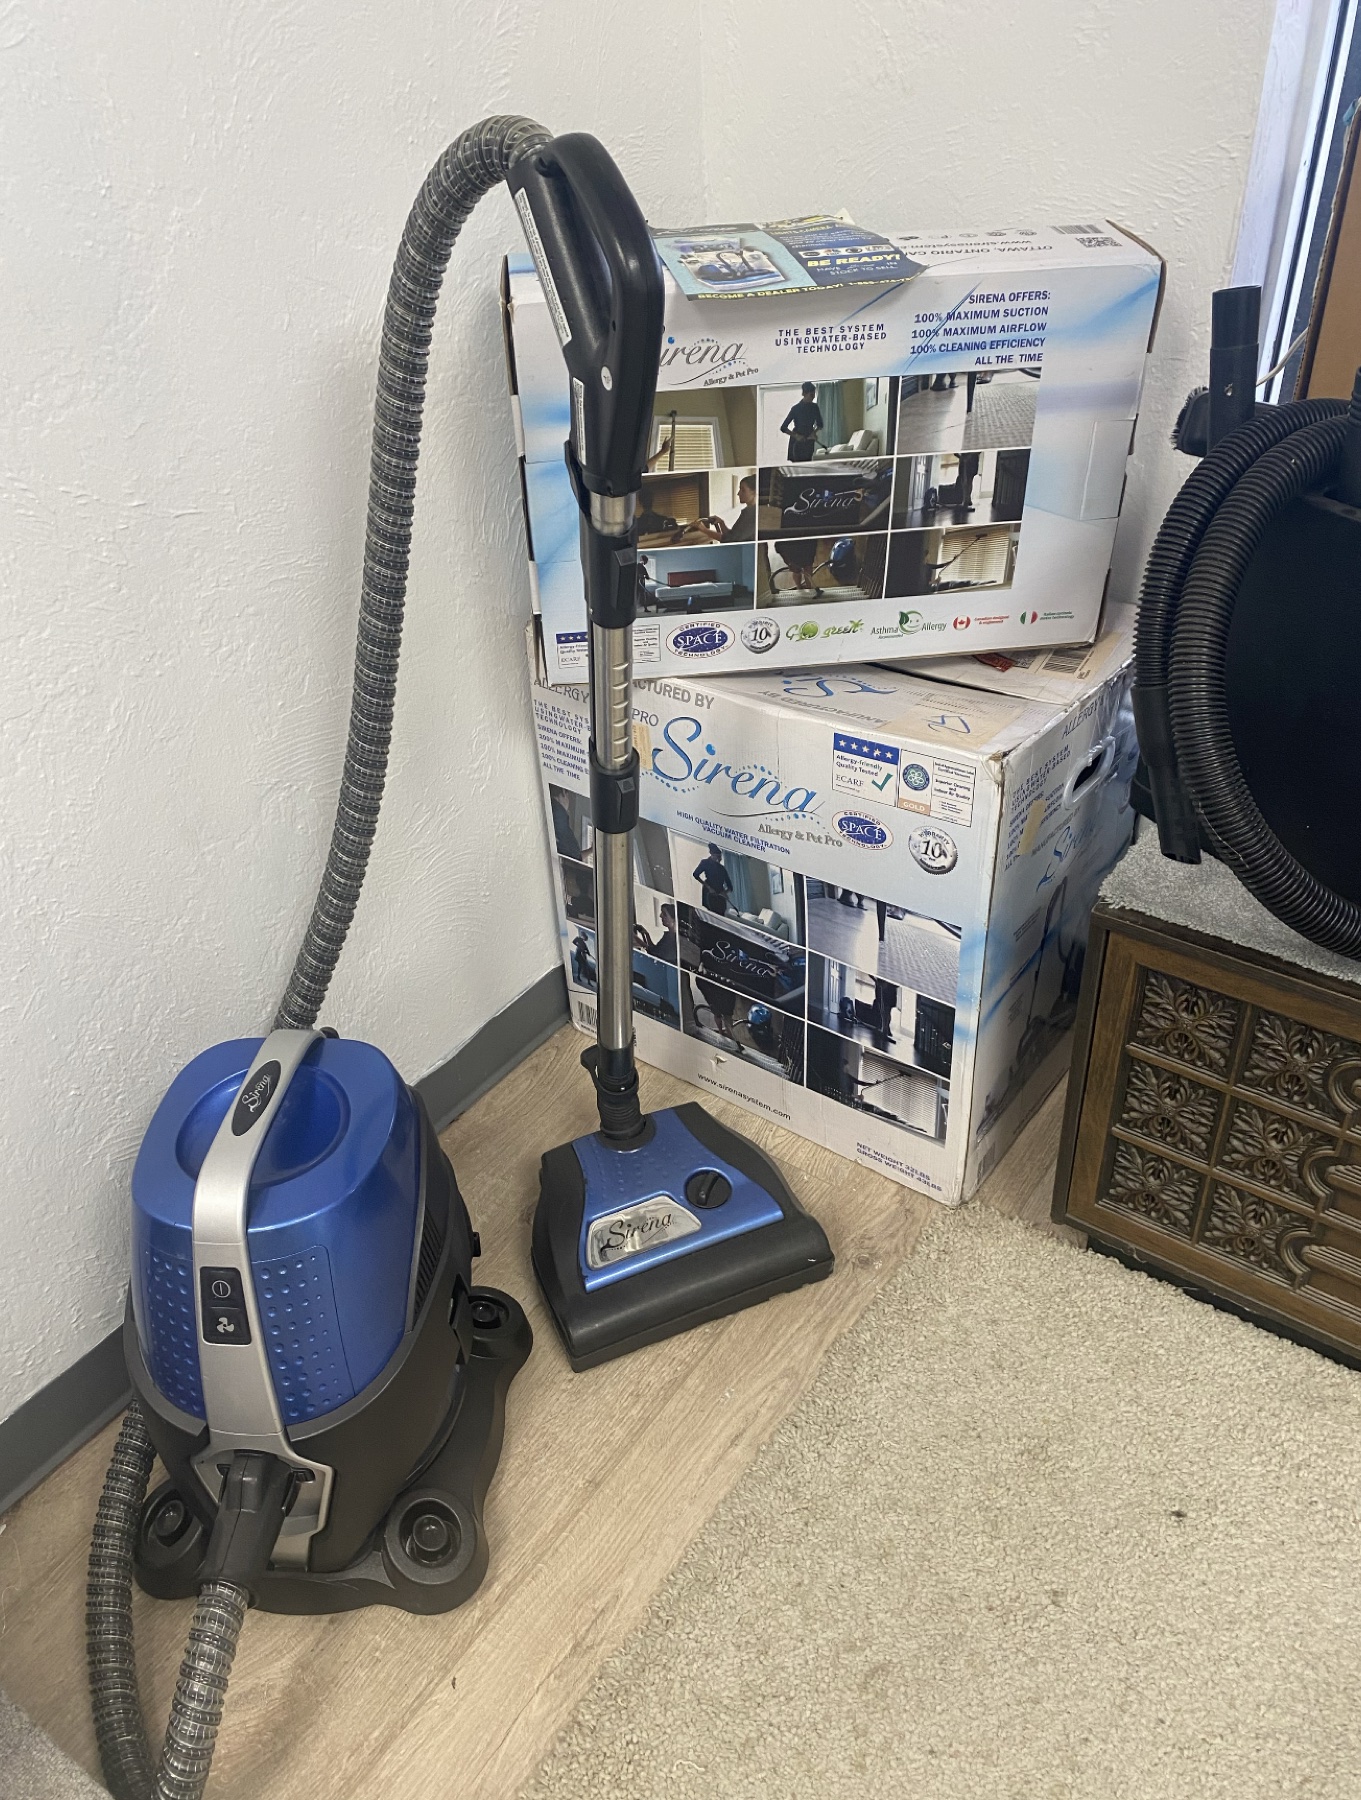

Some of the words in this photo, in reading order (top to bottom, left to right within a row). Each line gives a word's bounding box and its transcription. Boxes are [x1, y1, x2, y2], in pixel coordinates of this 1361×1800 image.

[836, 254, 900, 265] READY!
[698, 292, 743, 300] BECOME
[757, 288, 800, 297] DEALER
[801, 283, 844, 292] TODAY!
[969, 292, 1006, 305] SIRENA
[1008, 290, 1051, 302] OFFERS:
[914, 312, 942, 323] 100%
[946, 309, 1000, 321] MAXIMUM
[1003, 306, 1049, 318] SUCTION
[779, 328, 799, 337] THE
[805, 326, 834, 335] BEST
[839, 323, 885, 334] SYSTEM
[911, 328, 940, 339] 100%
[942, 325, 997, 337] MAXIMUM
[999, 322, 1047, 334] AIRFLOW
[660, 336, 747, 367] irena
[796, 343, 865, 354] TECHNOLOGY
[910, 344, 936, 355] 100%
[939, 340, 987, 353] CLEANING
[989, 337, 1045, 350] EFFICIENCY
[975, 356, 993, 366] ALL
[995, 354, 1013, 364] THE
[1019, 353, 1044, 363] TIME
[703, 373, 728, 387] Allergy
[728, 372, 735, 381] &
[735, 370, 746, 379] Pet
[747, 367, 759, 376] Pro
[678, 623, 721, 631] CERTIFIED
[751, 627, 769, 642] 10
[870, 626, 899, 635] Asthma
[921, 621, 948, 632] Allergy
[677, 630, 722, 646] SPACE
[534, 699, 548, 709] THE
[551, 706, 571, 718] BEST
[695, 693, 715, 709] BY
[535, 712, 582, 734] TECHNOLOGY
[631, 708, 659, 727] PRO
[537, 724, 557, 736] SIRENA
[558, 731, 582, 744] OFFERS:
[541, 743, 556, 753] 100%
[556, 749, 587, 764] MAXIMUM
[555, 739, 586, 755] MAXIMUM
[541, 752, 556, 762] 100%
[556, 758, 584, 773] CLEANING
[543, 761, 553, 770] ALL
[553, 765, 565, 774] THE
[566, 770, 581, 780] TIME
[652, 716, 818, 812] Sirena
[836, 761, 858, 772] Quality
[859, 767, 879, 777] Tested
[836, 774, 864, 787] ECARF
[903, 801, 926, 812] GOLD
[844, 811, 881, 825] CERTIFIED
[676, 810, 694, 822] HIGH
[695, 816, 723, 832] QUALITY
[724, 826, 749, 841] WATER
[750, 835, 791, 855] FILTRATION
[702, 825, 732, 841] VACUUM
[733, 836, 766, 853] CLEANER
[758, 823, 793, 841] Allergy
[794, 830, 804, 840] &
[806, 831, 824, 845] Pet
[824, 835, 843, 848] Pro
[841, 820, 882, 840] SPACE
[921, 840, 943, 859] 10
[240, 1073, 272, 1113] Sirena
[697, 1072, 791, 1121] www.sirenasystem.com
[857, 1142, 871, 1152] NET
[873, 1150, 904, 1167] WEIGHT
[905, 1165, 930, 1181] 32LBS
[857, 1148, 882, 1163] GROSS
[884, 1161, 915, 1178] WEIGHT
[601, 1214, 672, 1252] Sirena
